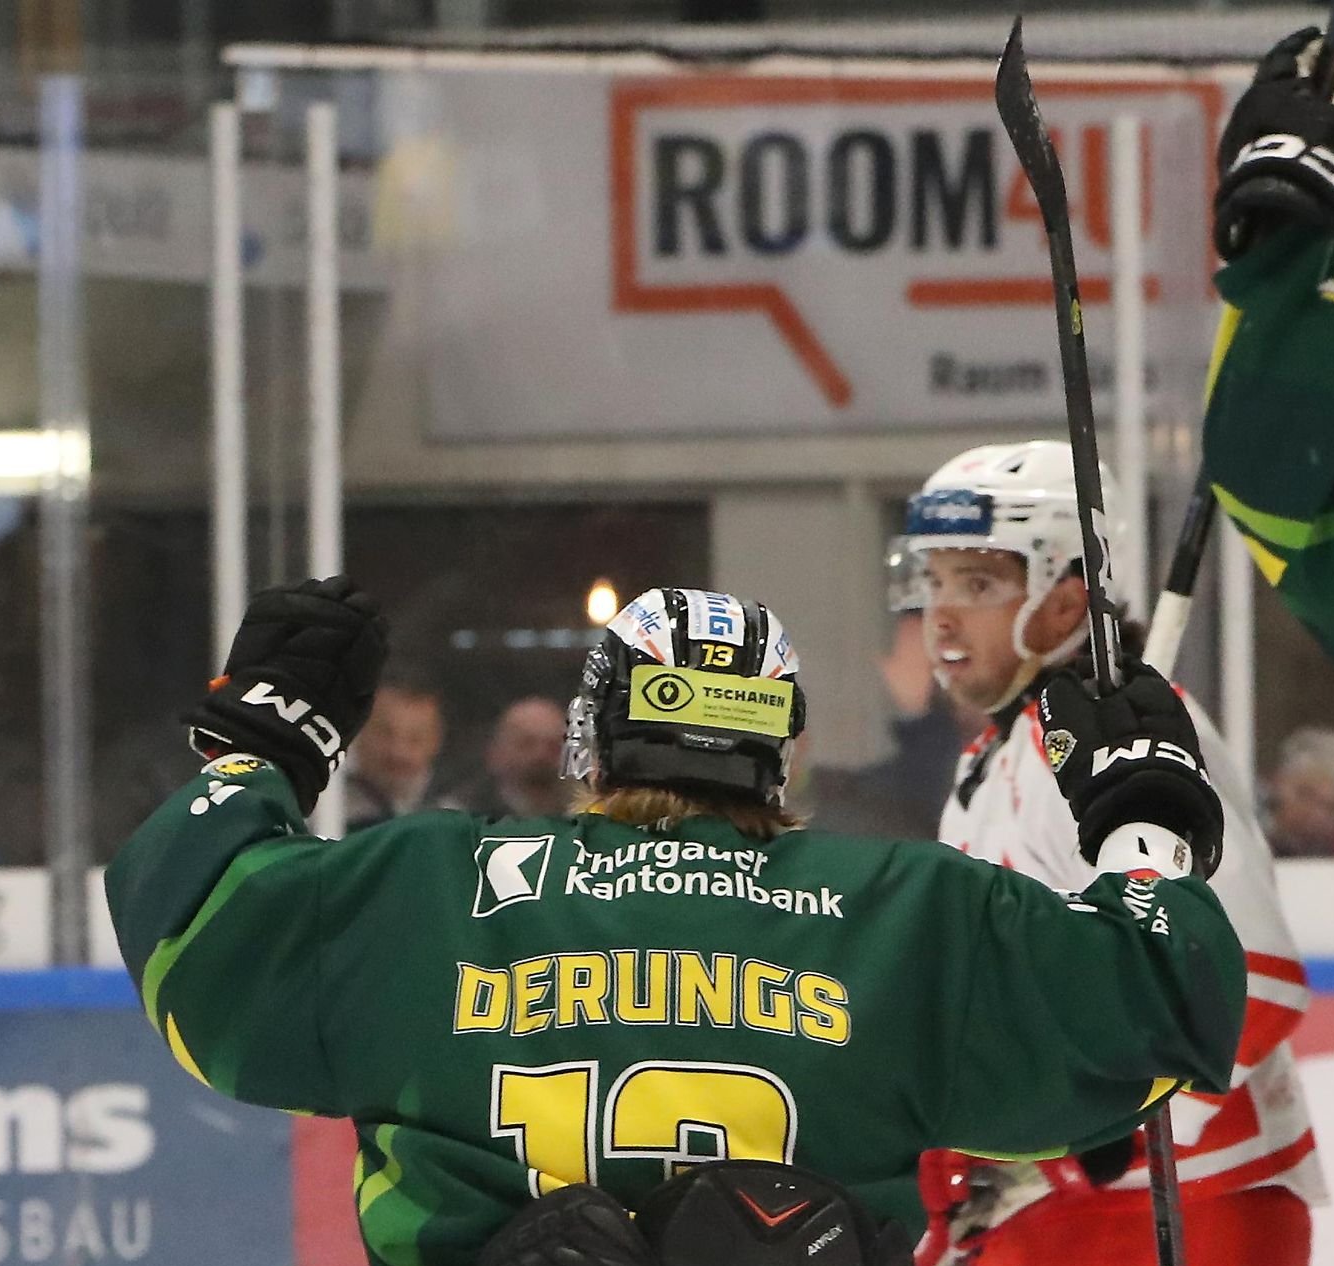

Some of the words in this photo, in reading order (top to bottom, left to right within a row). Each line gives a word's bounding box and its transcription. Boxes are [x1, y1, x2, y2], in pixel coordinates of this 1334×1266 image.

[701, 644, 736, 667] 13
[702, 686, 786, 709] TSCHANEN
[573, 837, 768, 878] Thurgauer
[564, 864, 845, 919] Kantonalbank
[453, 948, 852, 1047] DERUNGS
